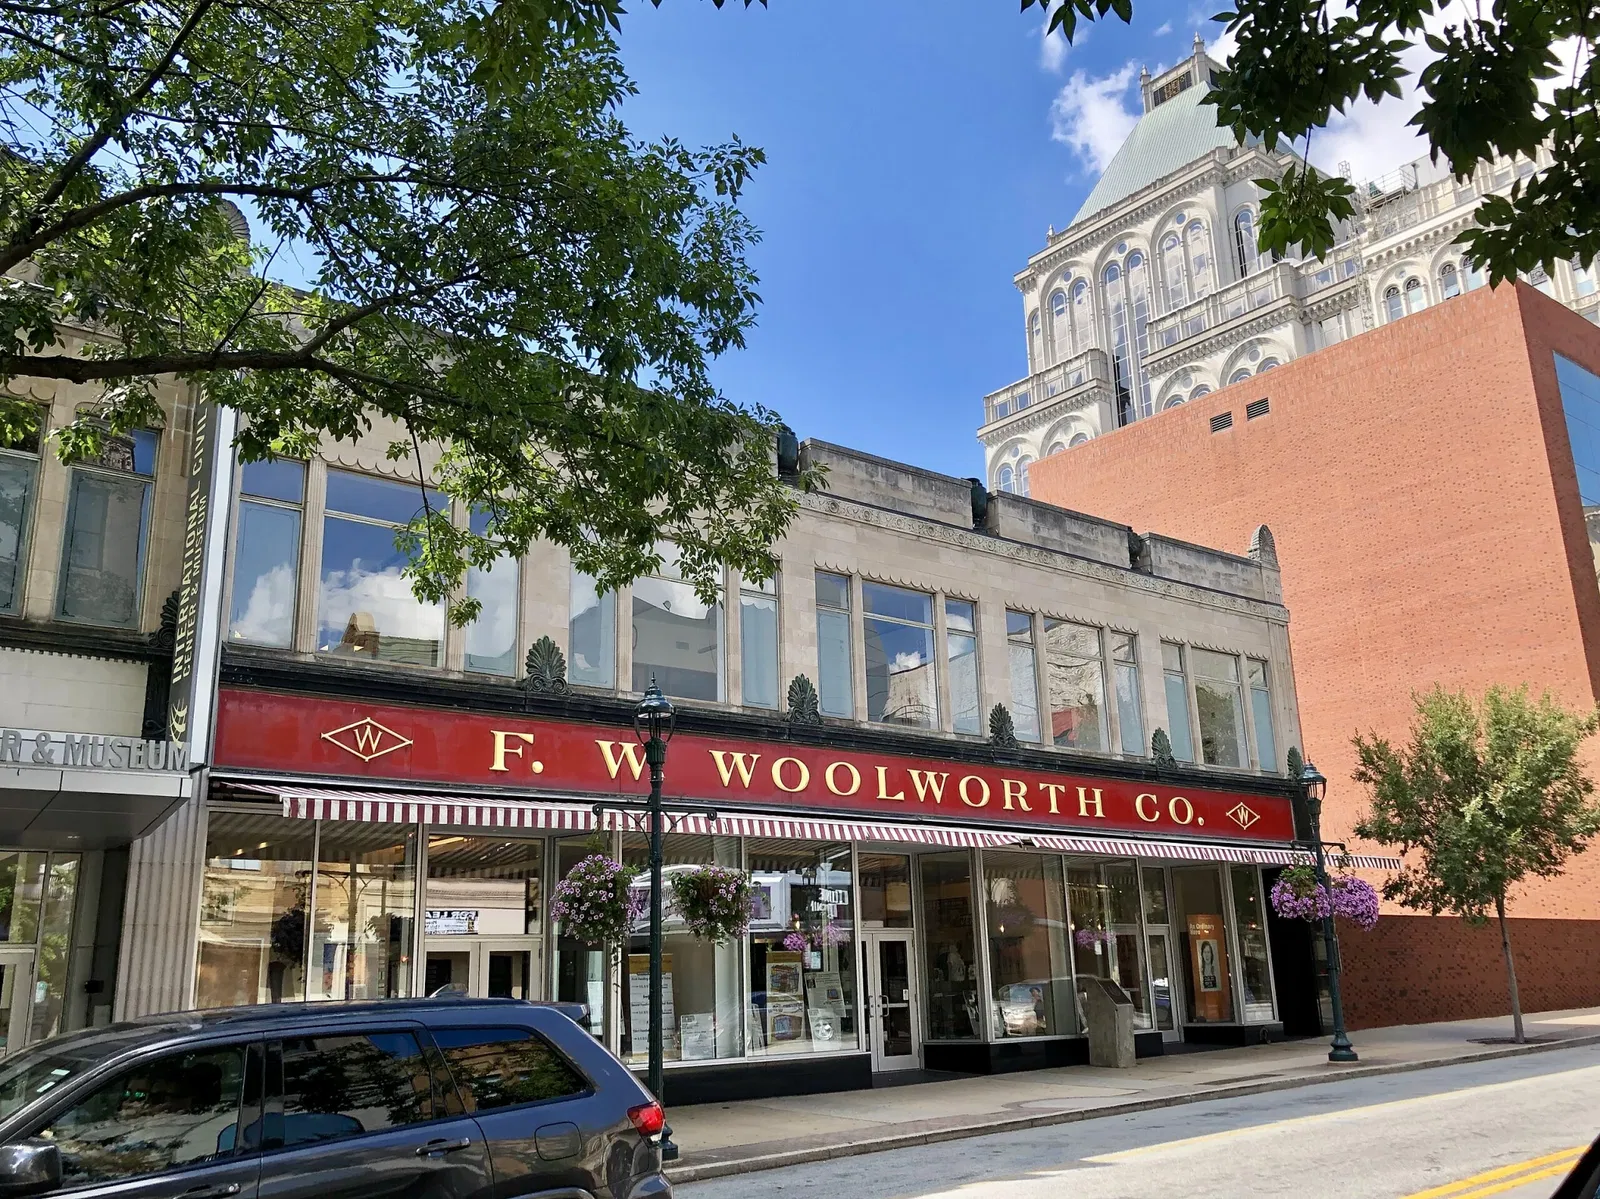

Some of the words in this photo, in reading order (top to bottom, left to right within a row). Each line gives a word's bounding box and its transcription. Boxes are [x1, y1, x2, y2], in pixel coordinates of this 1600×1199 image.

[173, 480, 201, 684] INTERNATIONAL
[192, 407, 208, 476] CIVIL
[192, 495, 207, 577] MUSEUM
[190, 581, 199, 597] &
[182, 602, 197, 678] CENTER
[32, 731, 54, 764] &
[63, 734, 191, 772] MUSEUM
[353, 724, 383, 752] W
[488, 730, 544, 774] F.
[708, 749, 1107, 818] WOOLWORTH
[1135, 793, 1205, 826] CO.
[1237, 806, 1250, 825] W
